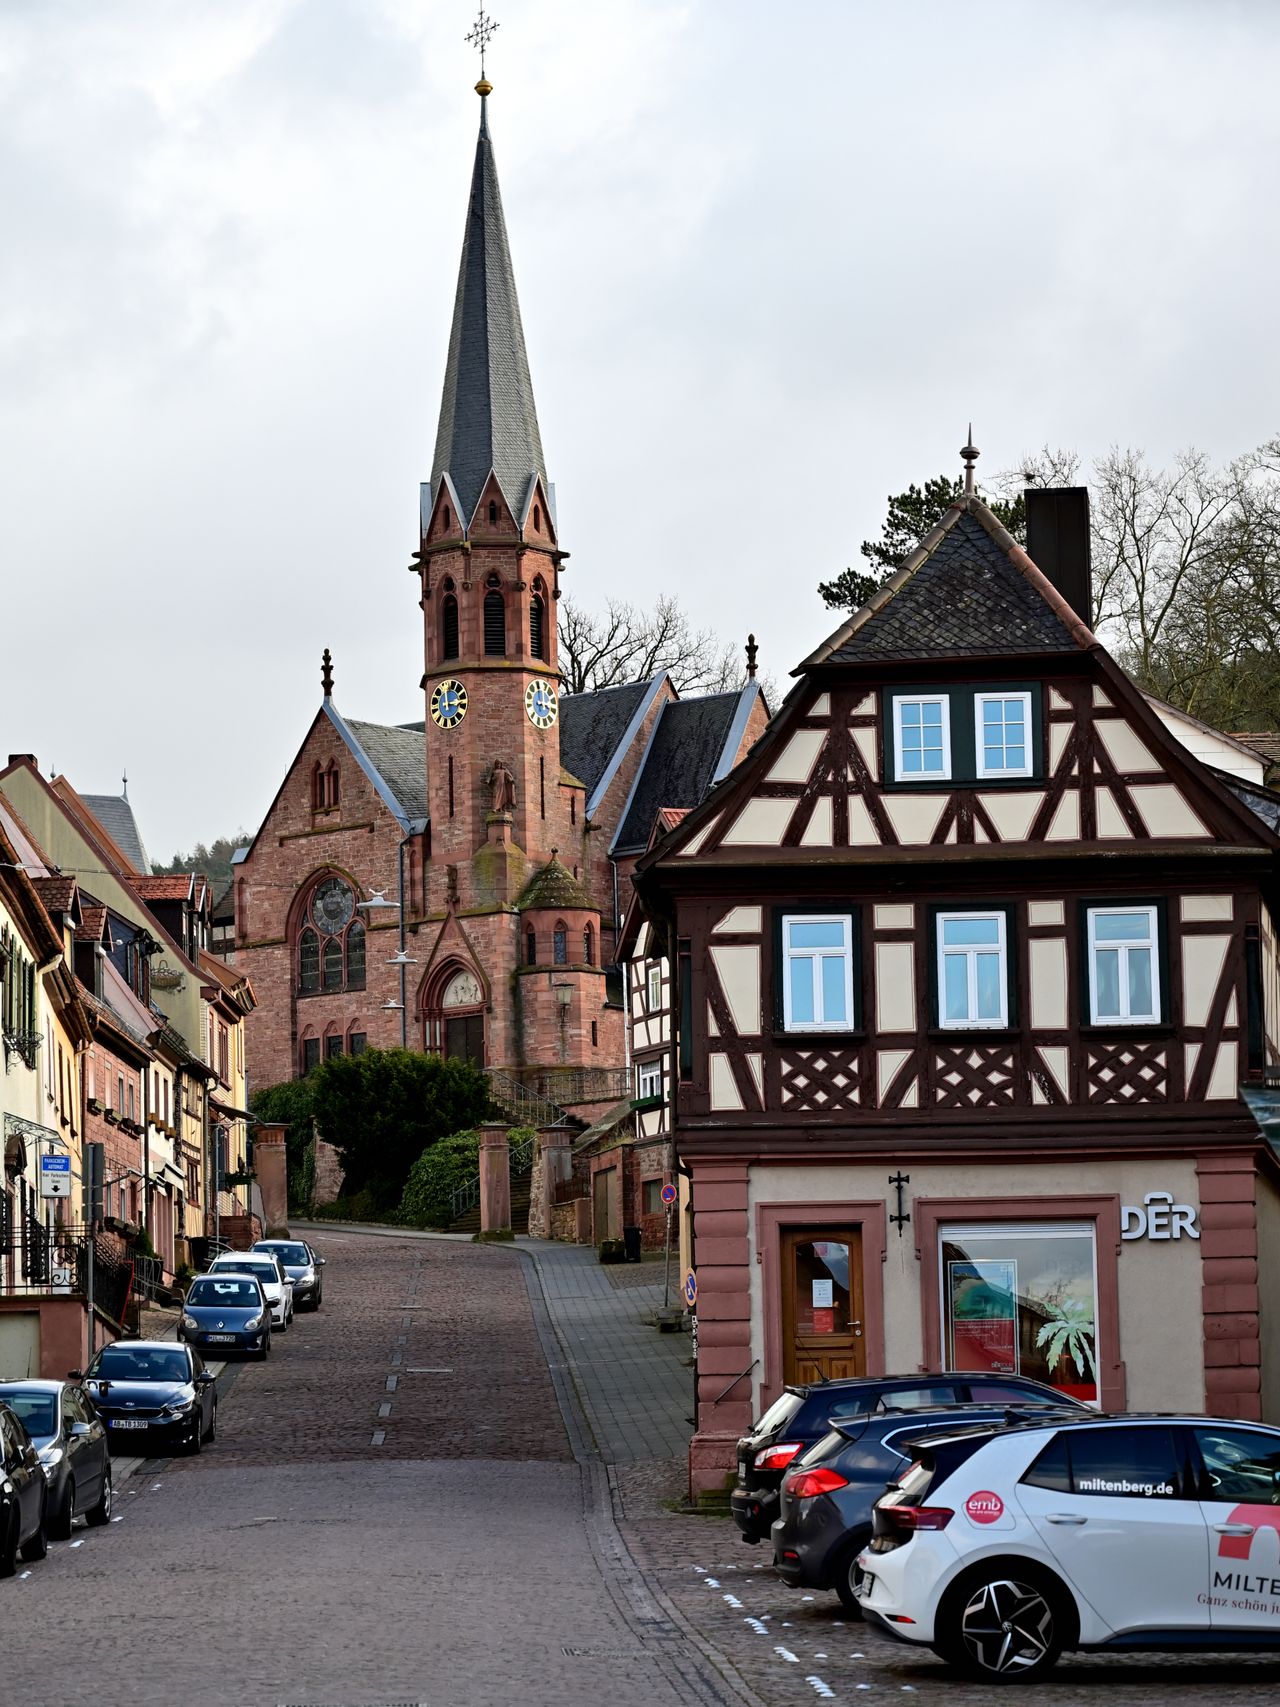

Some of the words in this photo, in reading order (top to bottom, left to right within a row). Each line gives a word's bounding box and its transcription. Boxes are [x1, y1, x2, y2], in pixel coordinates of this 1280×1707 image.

[1121, 1191, 1200, 1239] DER
[1080, 1478, 1174, 1496] miltenberg.de
[968, 1498, 1001, 1511] emb
[1213, 1571, 1280, 1595] MILTE
[1197, 1593, 1228, 1607] Ganz
[1231, 1599, 1268, 1613] schön
